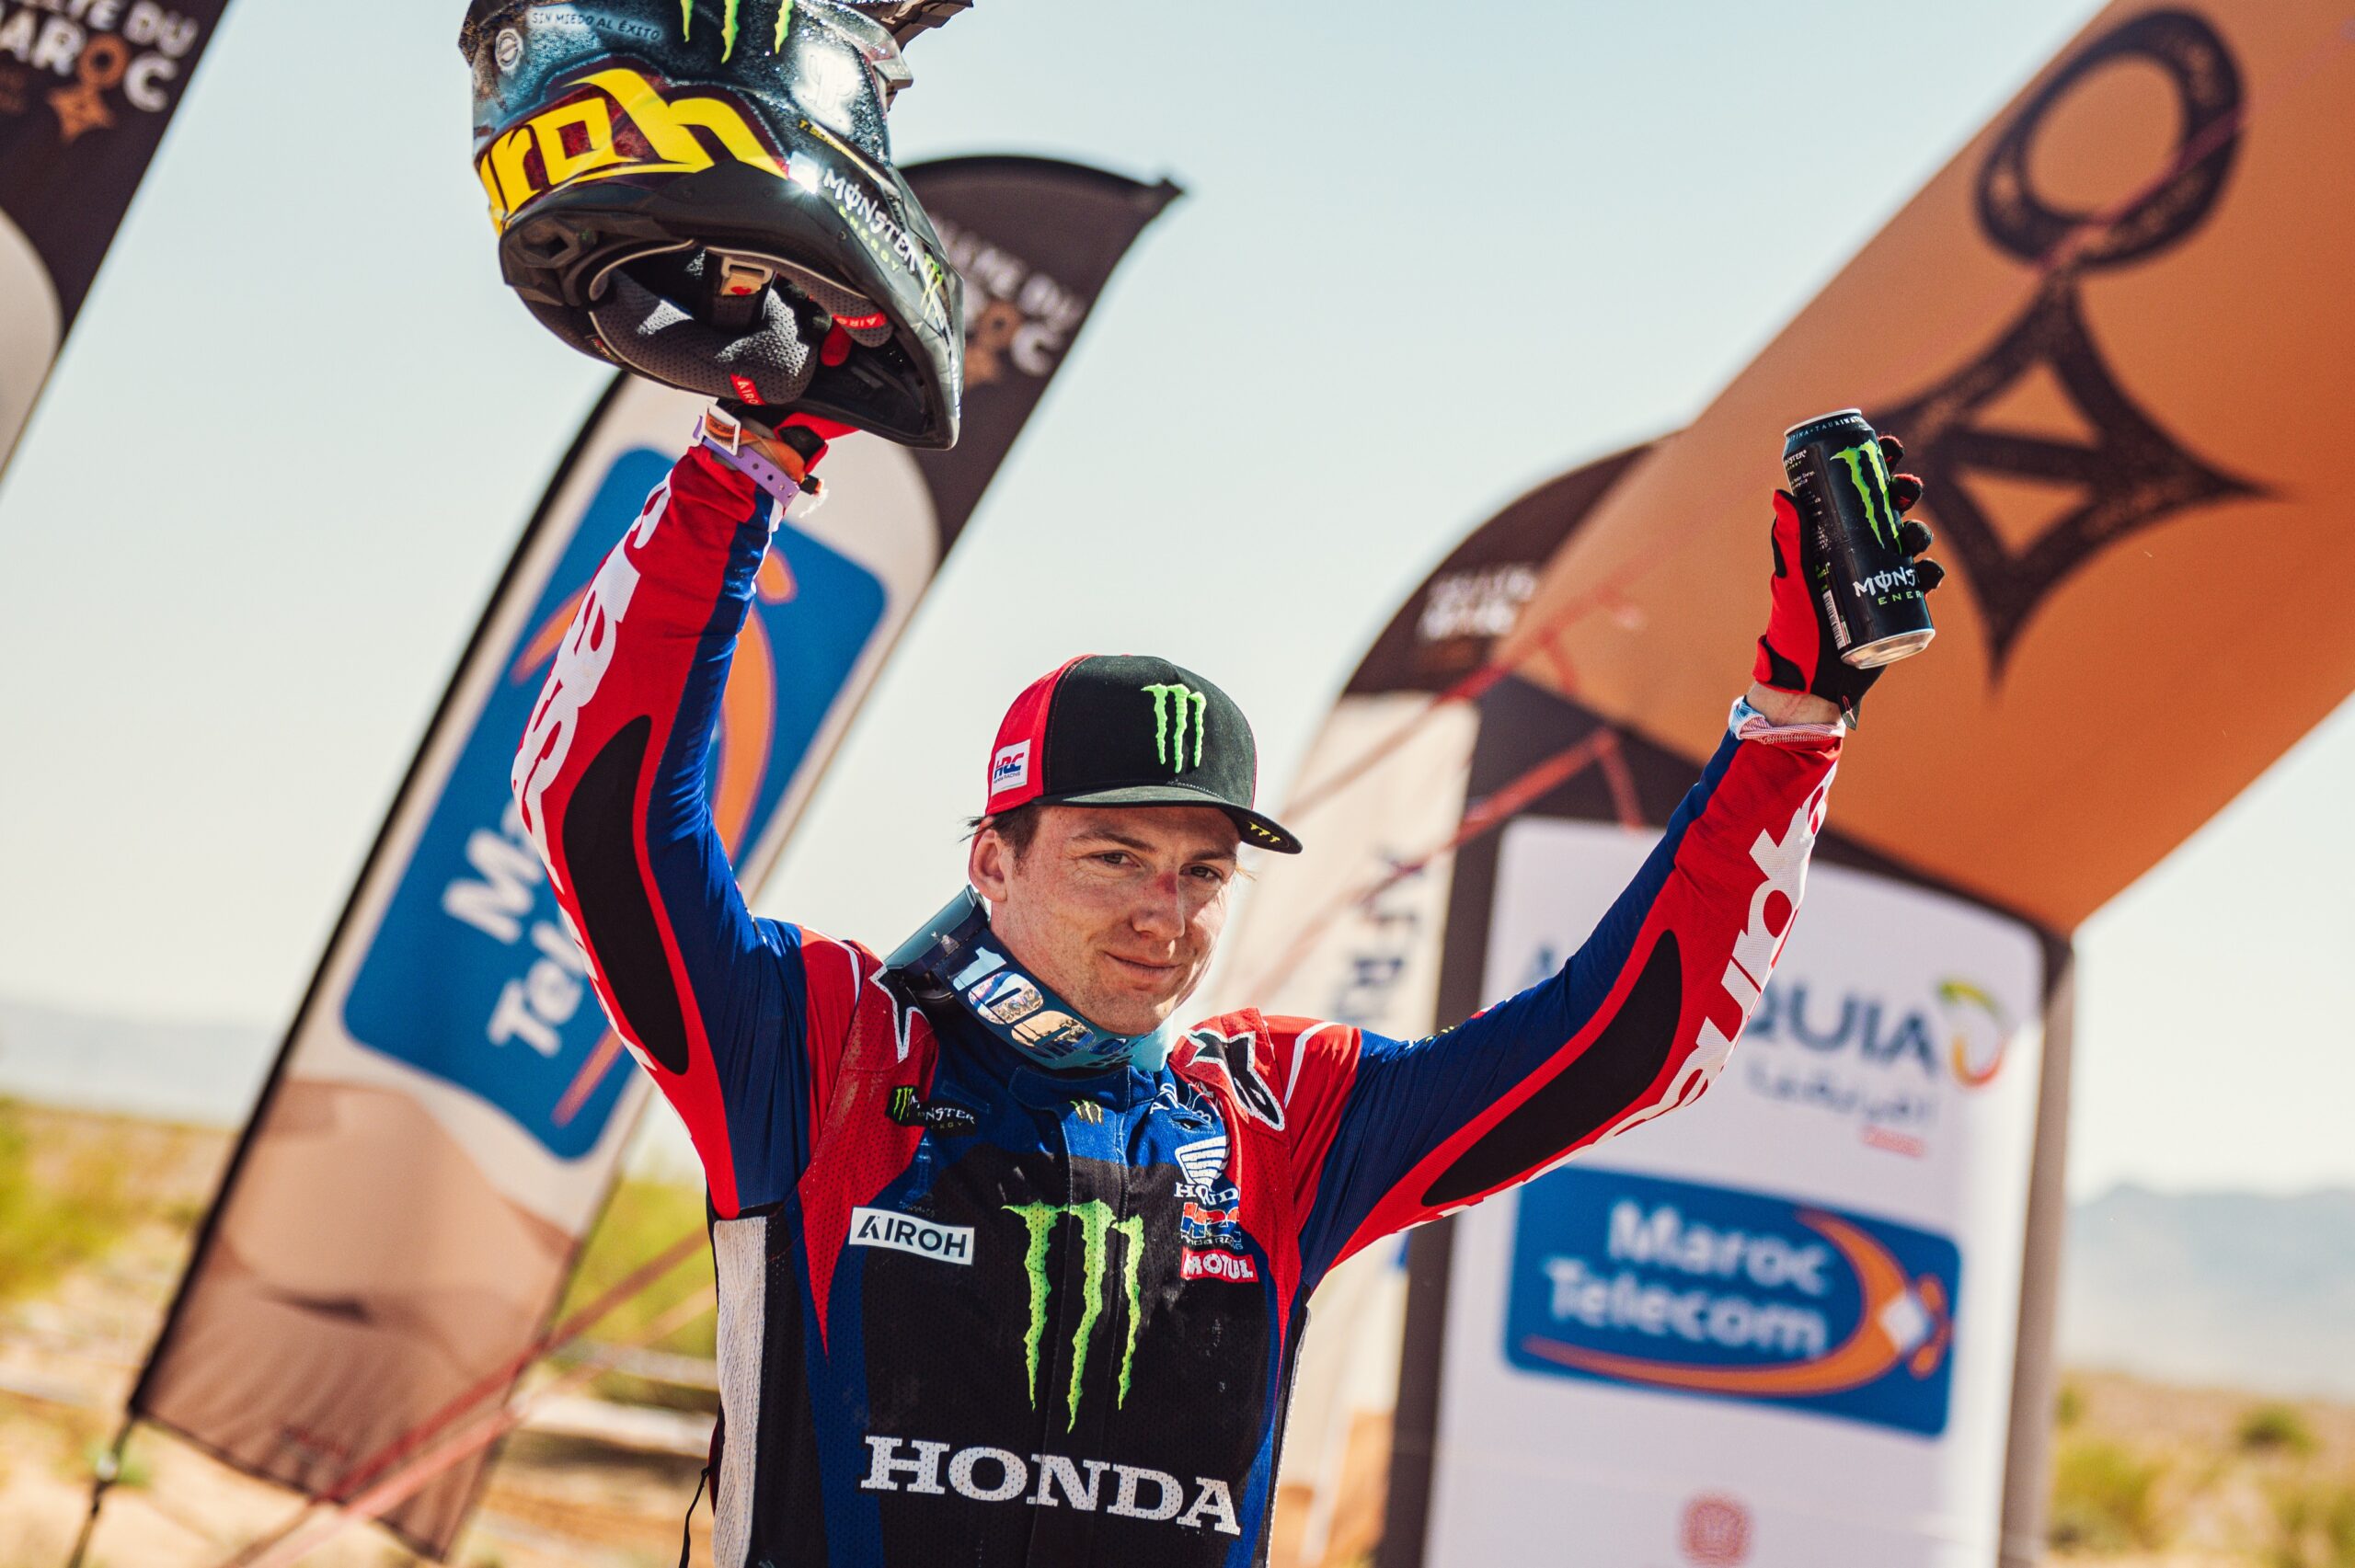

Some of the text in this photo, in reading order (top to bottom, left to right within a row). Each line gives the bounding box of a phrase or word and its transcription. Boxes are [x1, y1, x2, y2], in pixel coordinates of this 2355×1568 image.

[556, 14, 594, 26] MIEDO
[598, 17, 614, 30] AL
[0, 7, 179, 112] AROC
[737, 380, 759, 406] AIRO
[1853, 567, 1920, 598] MONS
[1878, 589, 1922, 605] ENER
[994, 751, 1025, 780] HRC
[910, 1094, 976, 1125] MNSTER
[1174, 1182, 1242, 1207] HOND
[857, 1214, 968, 1258] AIROH
[1607, 1199, 1831, 1297] Maroc
[1182, 1253, 1254, 1280] MOTUL
[1546, 1255, 1831, 1359] Telecom
[860, 1435, 1241, 1536] HONDA
